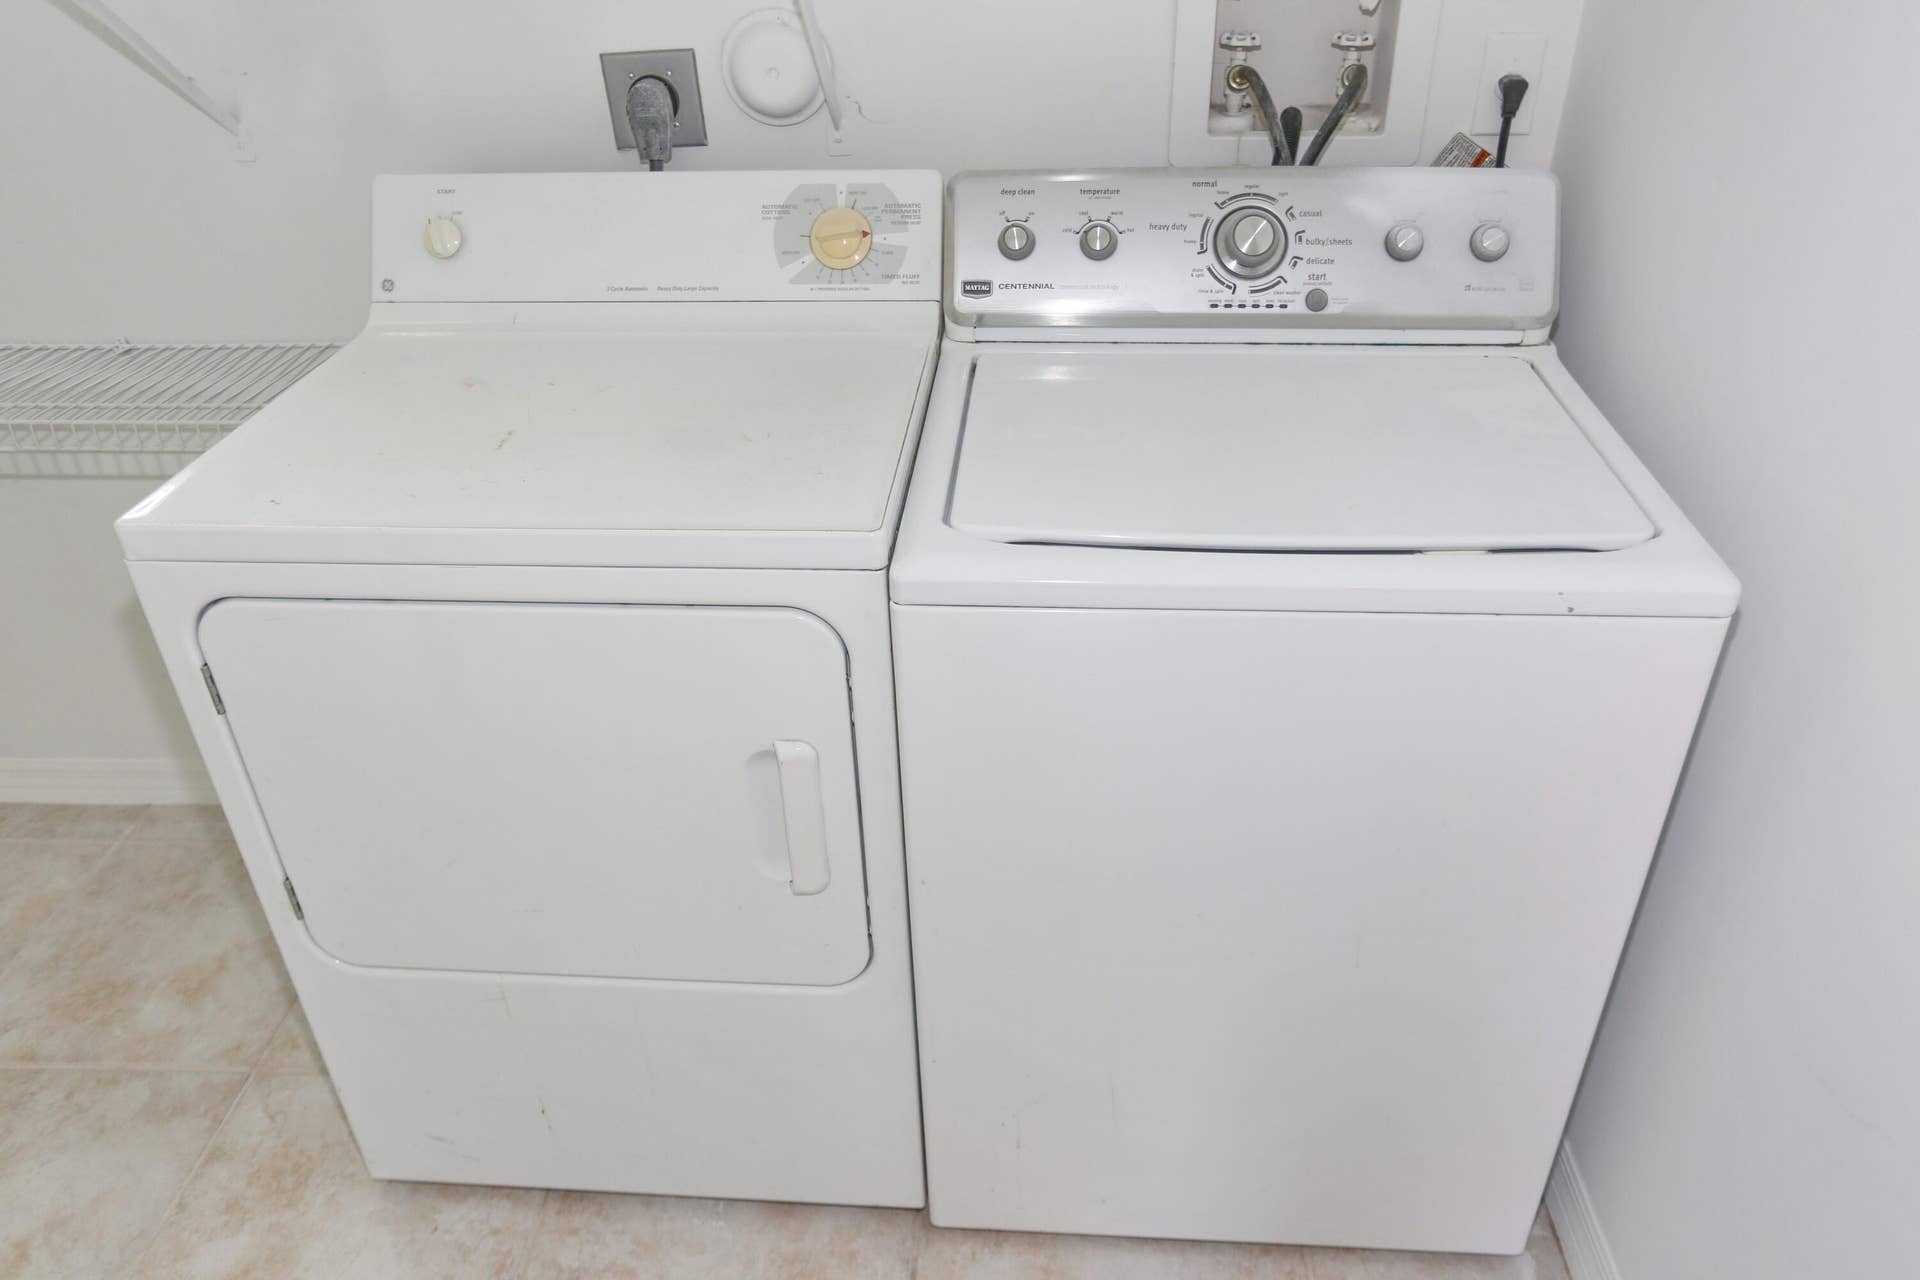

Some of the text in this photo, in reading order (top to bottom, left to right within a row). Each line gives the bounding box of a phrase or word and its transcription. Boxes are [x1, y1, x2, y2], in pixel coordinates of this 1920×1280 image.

[1192, 180, 1217, 188] normal
[1000, 187, 1035, 197] deep clean
[1080, 188, 1120, 197] temperature
[1299, 209, 1323, 217] casual
[1149, 223, 1187, 232] heavy duty
[1305, 236, 1352, 247] bulky/sheets
[1306, 256, 1335, 265] delicate
[1308, 272, 1327, 281] start
[964, 283, 991, 291] MAYTAG
